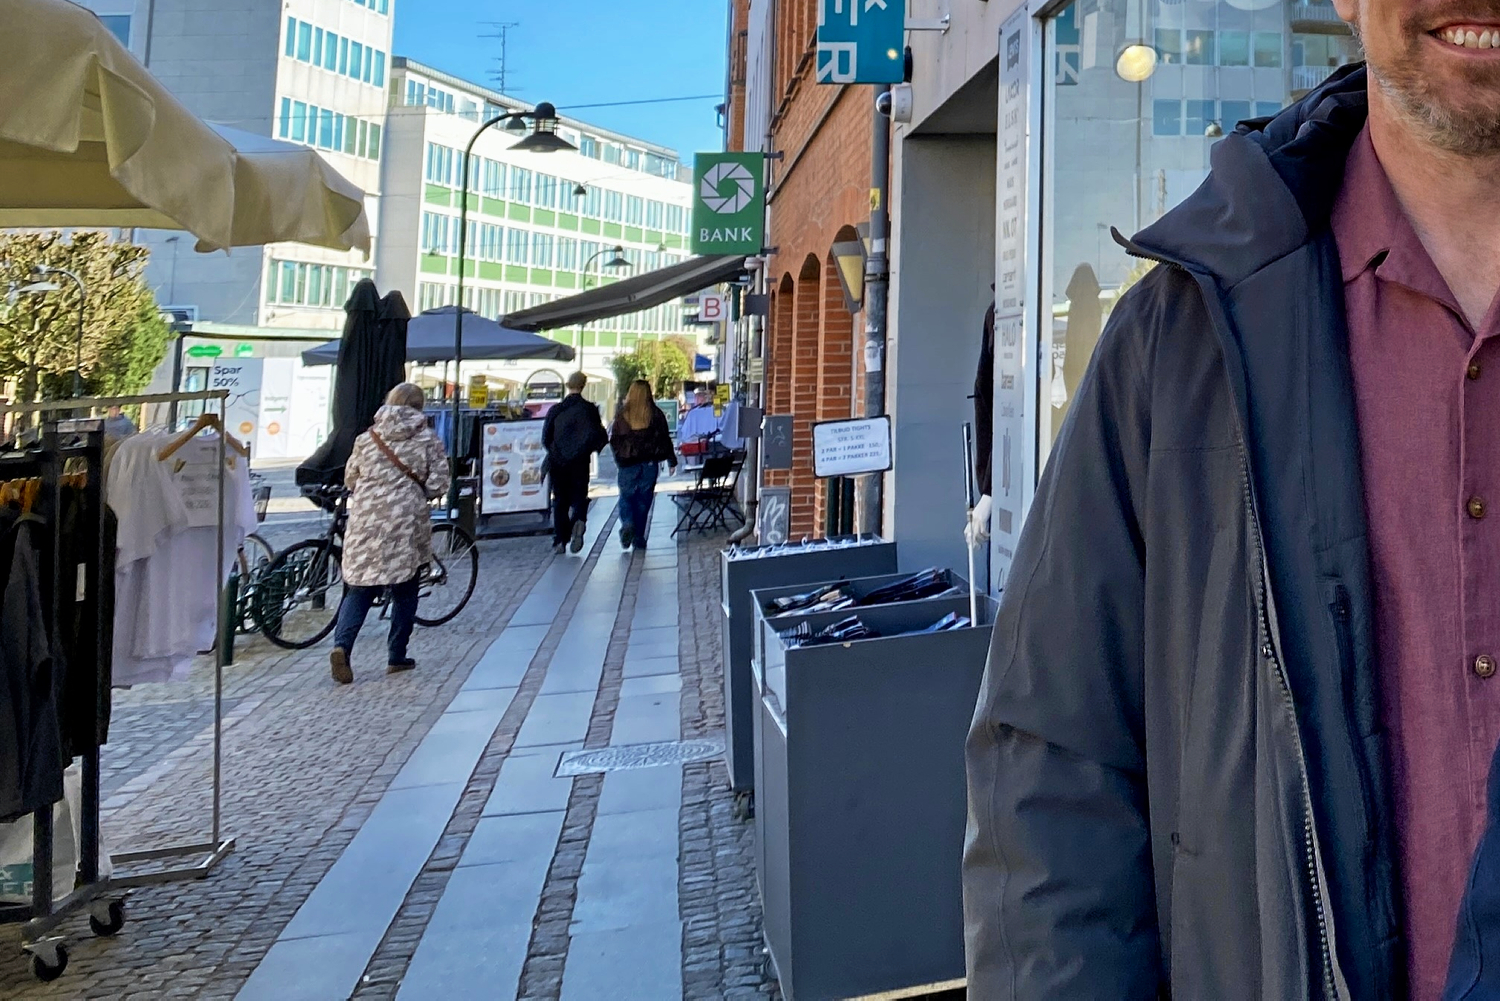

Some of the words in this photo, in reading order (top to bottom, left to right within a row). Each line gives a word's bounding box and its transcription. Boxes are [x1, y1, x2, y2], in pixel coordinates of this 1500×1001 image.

[700, 227, 752, 242] BANK
[704, 298, 721, 318] B
[214, 366, 243, 376] Spar
[213, 378, 240, 387] 50%
[831, 426, 850, 434] TILBUD
